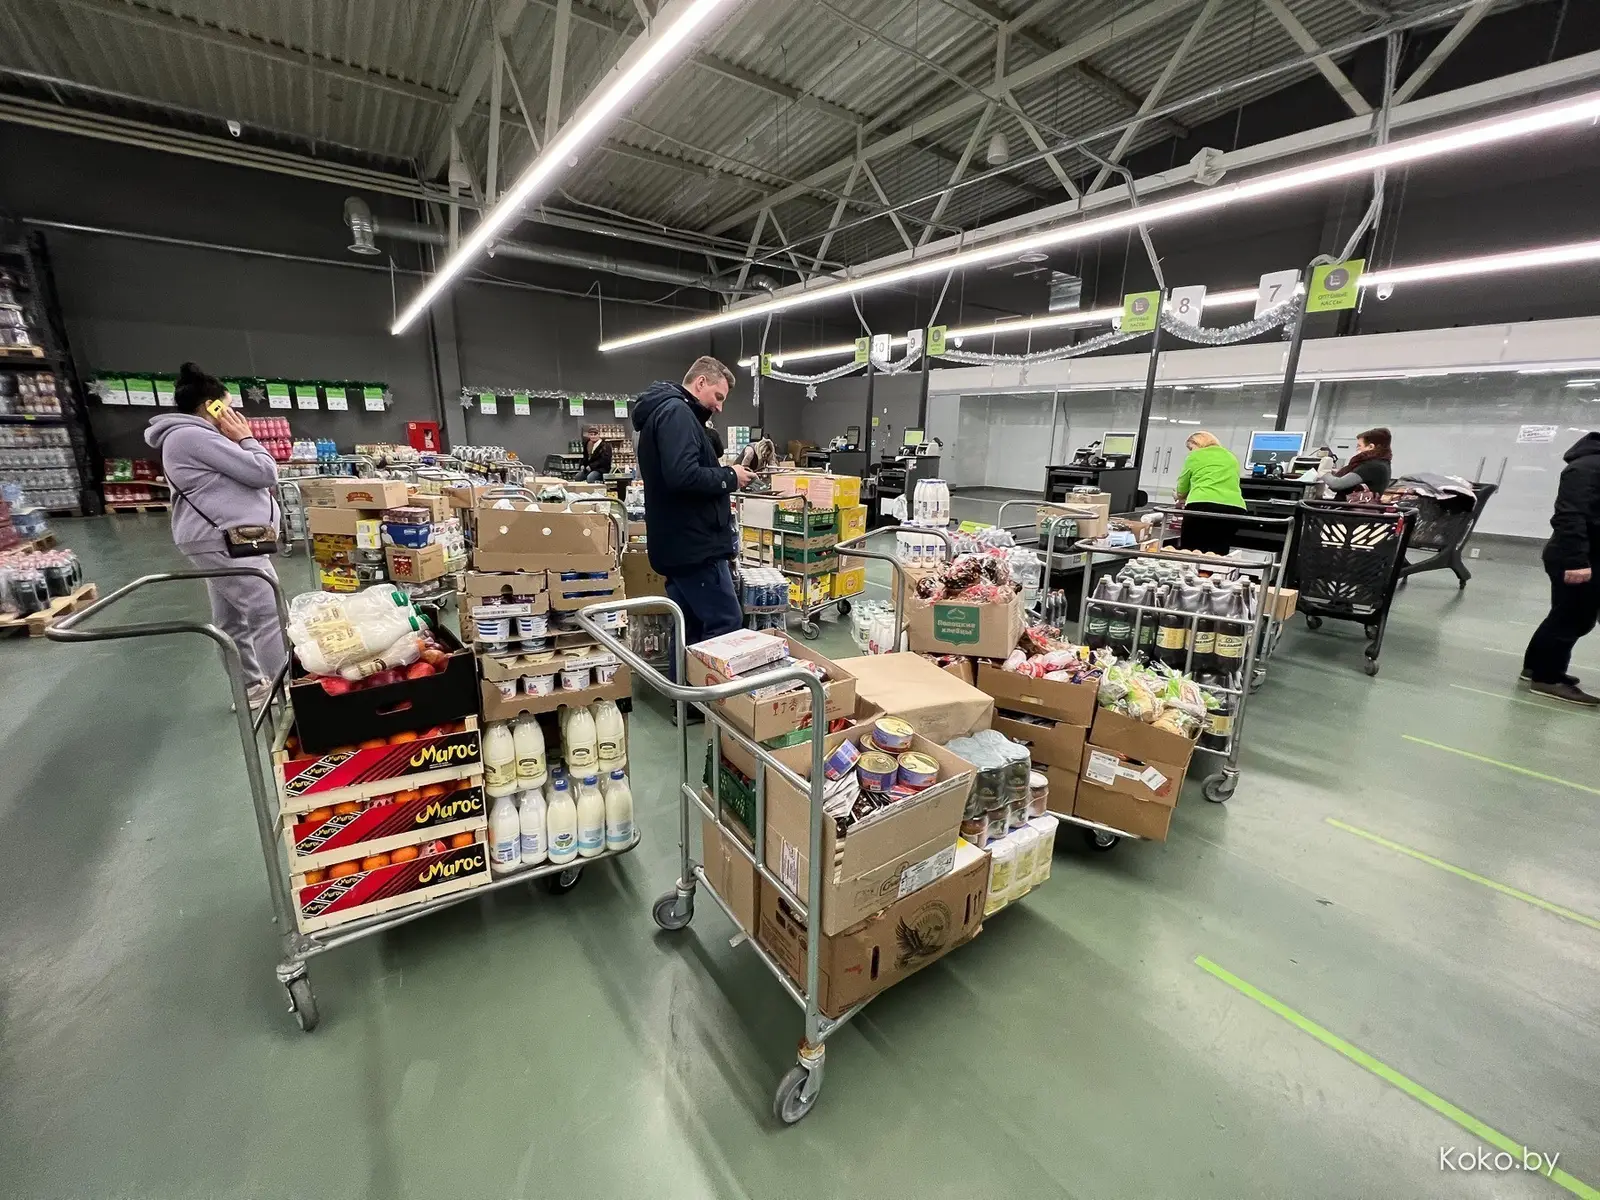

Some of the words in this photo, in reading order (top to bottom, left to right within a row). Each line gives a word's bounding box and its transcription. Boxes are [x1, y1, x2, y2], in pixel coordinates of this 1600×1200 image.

[1270, 284, 1282, 302] 7
[1178, 297, 1190, 314] 8
[874, 341, 885, 353] 10
[910, 337, 916, 349] 9
[1270, 452, 1277, 461] 2
[410, 743, 479, 767] Maroc
[287, 779, 312, 790] Maroc
[416, 798, 482, 823] Maroc
[419, 856, 483, 883] Maroc
